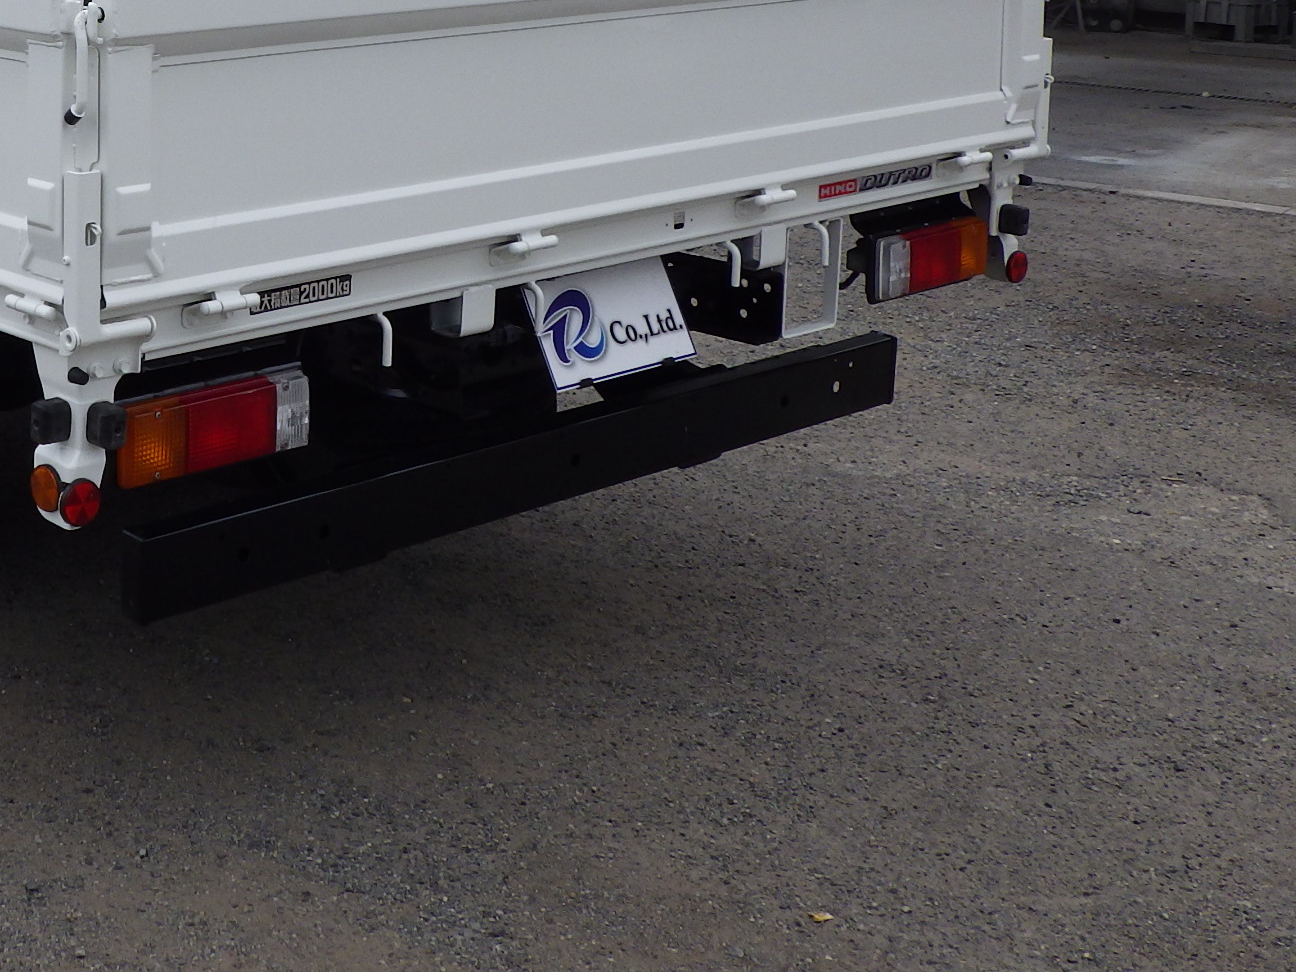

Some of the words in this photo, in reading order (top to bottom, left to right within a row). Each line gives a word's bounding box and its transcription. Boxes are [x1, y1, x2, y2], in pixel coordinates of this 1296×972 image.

[820, 181, 856, 197] HINO
[859, 164, 933, 191] DUTRO
[609, 308, 684, 345] Co.,Ltd.
